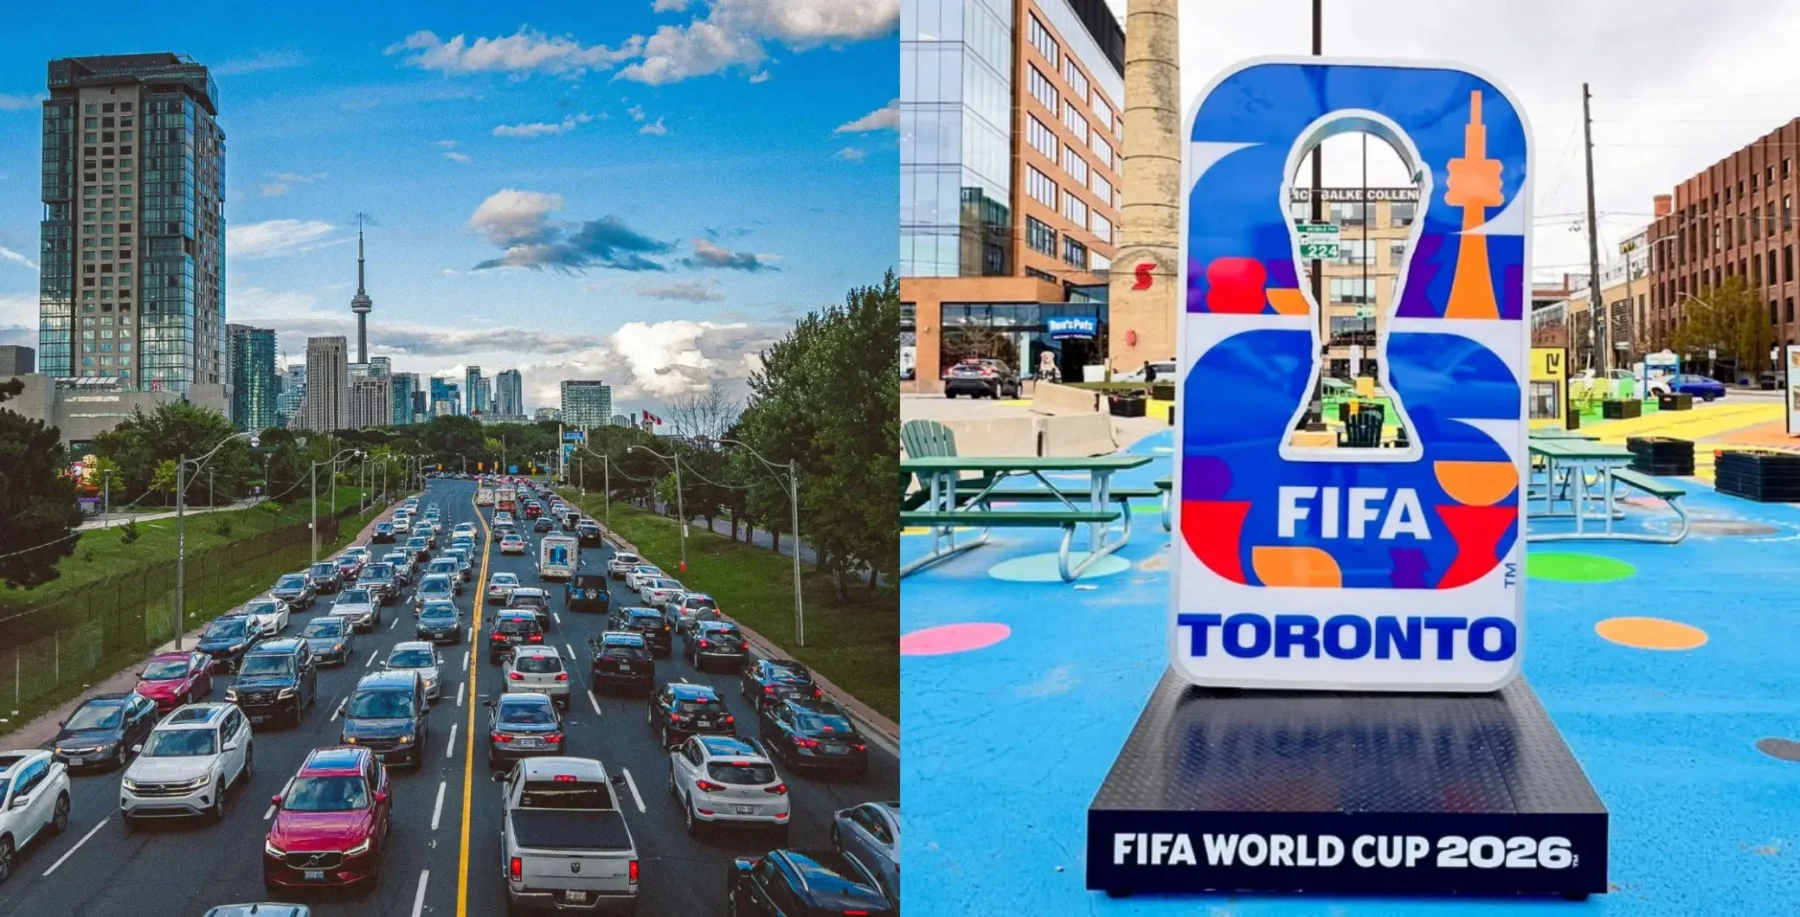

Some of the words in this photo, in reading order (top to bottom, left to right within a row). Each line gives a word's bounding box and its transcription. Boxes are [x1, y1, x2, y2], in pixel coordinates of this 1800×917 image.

[1321, 190, 1363, 200] BALKE
[1307, 245, 1338, 257] 224
[1278, 486, 1432, 540] FIFA
[1503, 562, 1517, 589] TM
[1177, 612, 1517, 663] TORONTO
[1113, 832, 1197, 866] FIFA
[1202, 833, 1343, 867] WORLD
[1351, 834, 1430, 868] CUP
[1436, 835, 1573, 869] 2026
